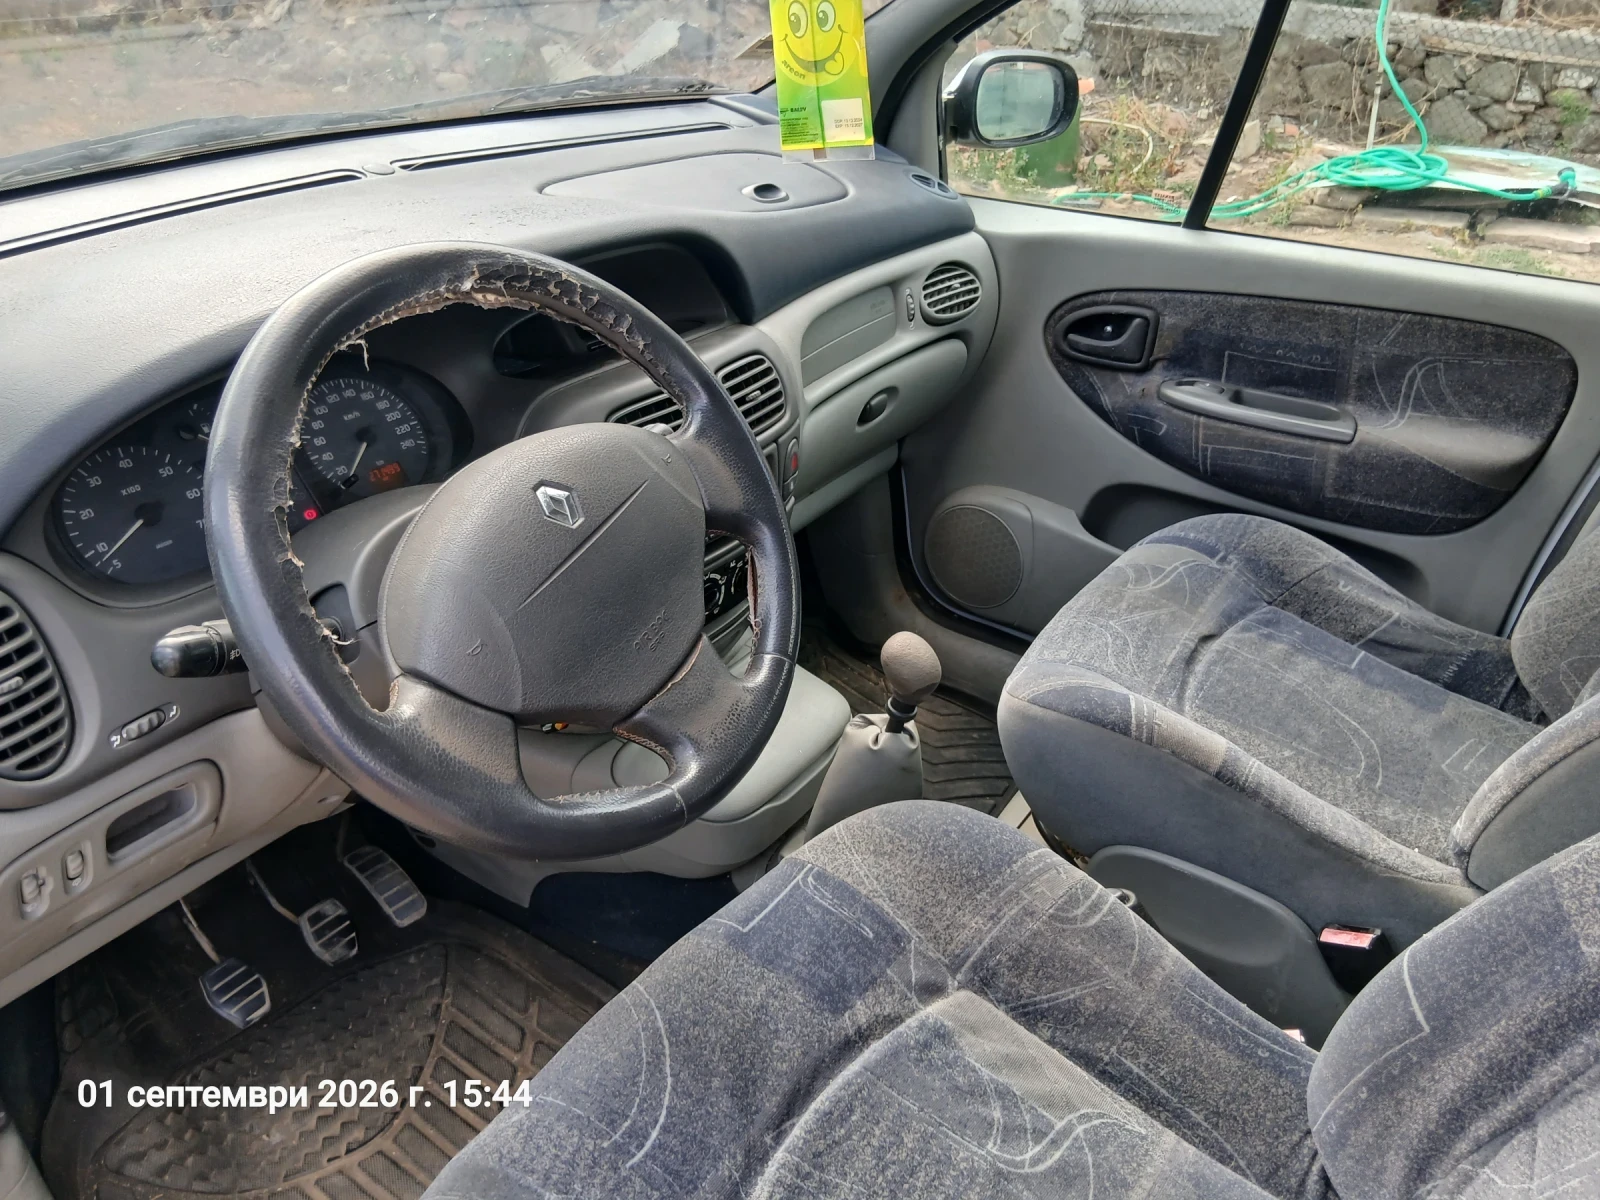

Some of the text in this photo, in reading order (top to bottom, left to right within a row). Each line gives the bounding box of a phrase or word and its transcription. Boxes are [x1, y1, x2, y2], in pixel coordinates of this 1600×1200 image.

[781, 59, 806, 80] areon
[325, 393, 340, 403] 120
[342, 388, 356, 398] 140
[360, 391, 375, 401] 160
[313, 405, 329, 416] 100
[343, 411, 361, 421] km/h
[384, 410, 402, 422] 200
[311, 420, 325, 430] 80
[395, 424, 411, 435] 220
[313, 436, 327, 446] 60
[400, 439, 416, 449] 240
[322, 452, 334, 461] 40
[118, 458, 133, 468] 40
[158, 466, 174, 477] 50
[335, 465, 348, 476] 20
[86, 476, 102, 487] 30
[185, 488, 201, 499] 60
[79, 508, 95, 520] 20
[96, 541, 109, 553] 10
[112, 559, 122, 569] 5
